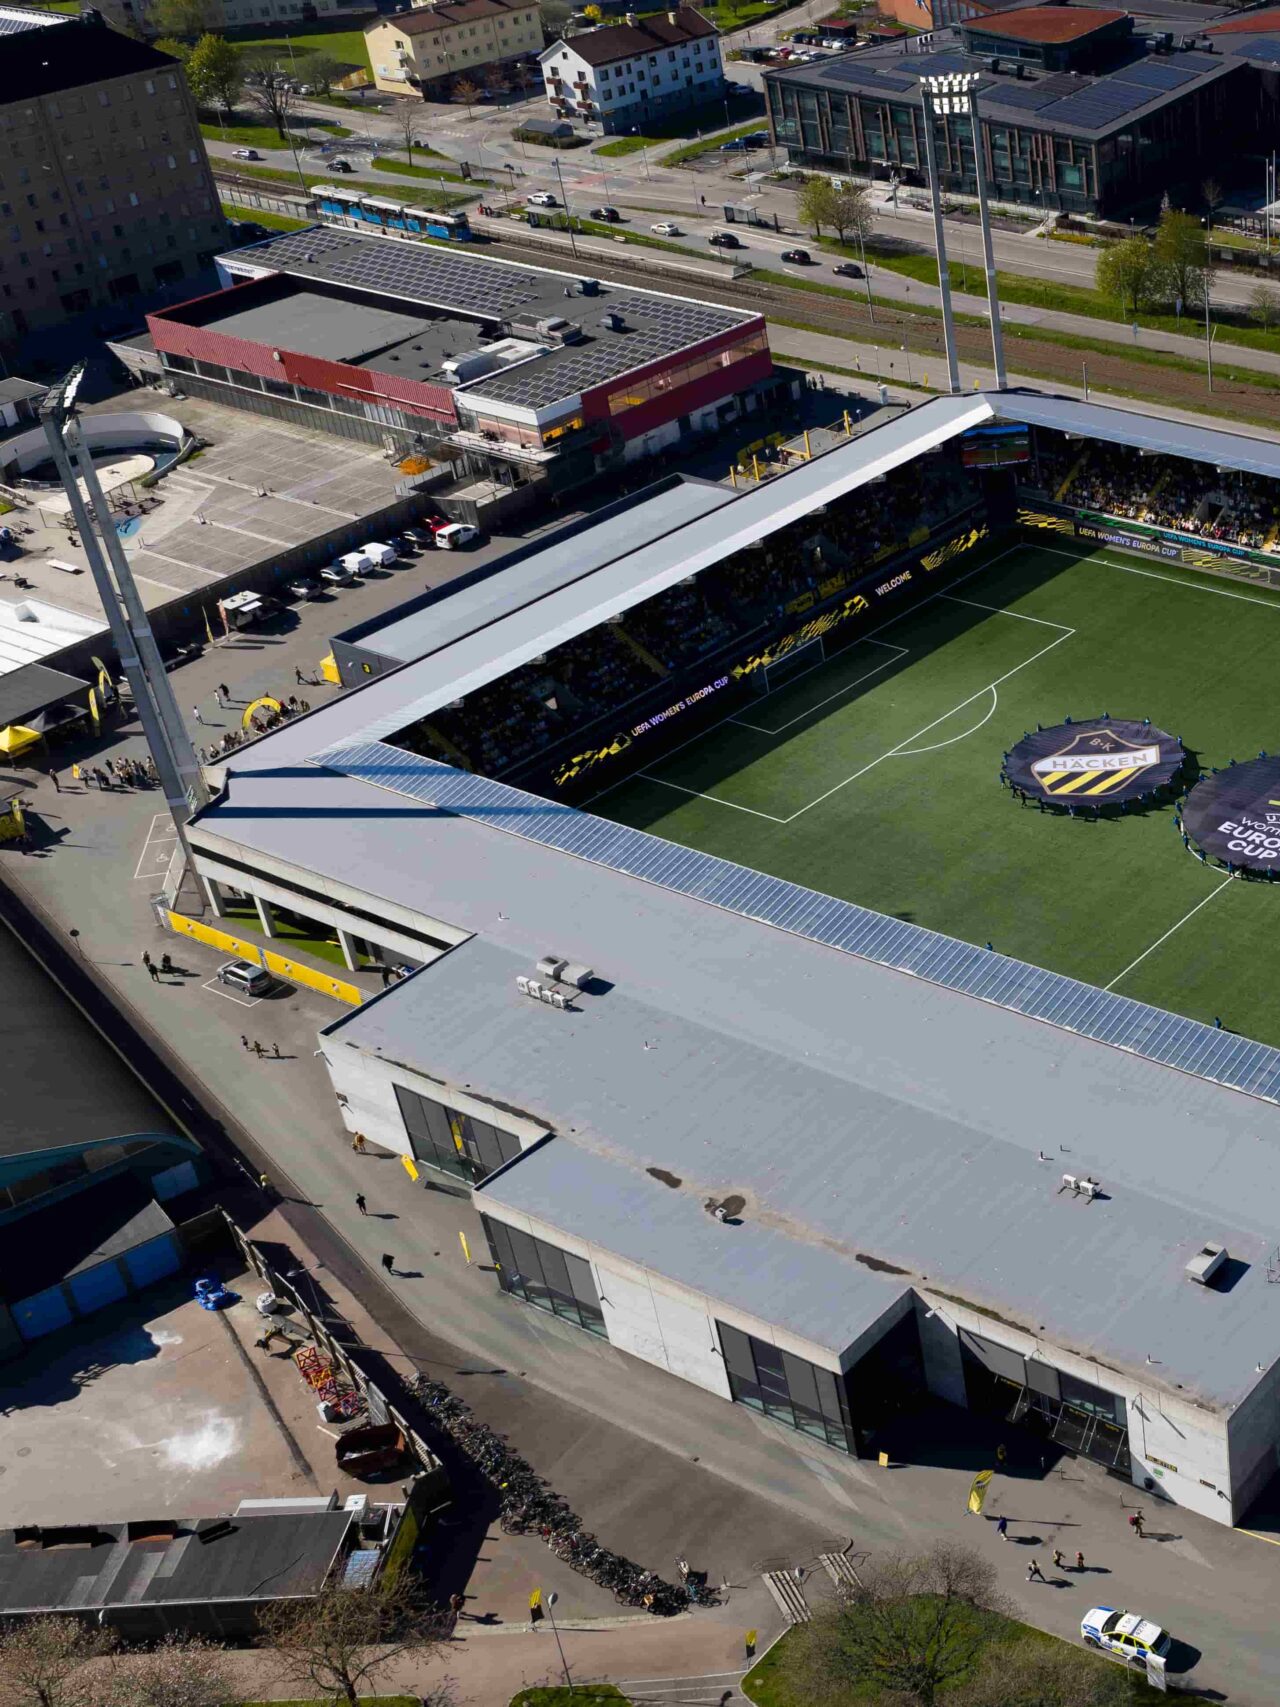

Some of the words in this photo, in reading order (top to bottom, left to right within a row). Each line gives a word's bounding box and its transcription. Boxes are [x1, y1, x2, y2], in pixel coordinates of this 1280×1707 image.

[1079, 527, 1096, 538] UEFA
[1097, 532, 1130, 546] WOMEN'S
[1132, 540, 1160, 553] EUROPA
[1161, 547, 1178, 557] CUP
[1163, 532, 1178, 541] UEFA
[1178, 535, 1206, 547] WOMEN'S
[1207, 542, 1231, 554] EUROPA
[1232, 548, 1246, 556] CUP
[875, 570, 913, 596] WELCOME
[631, 722, 651, 737] UEFA
[650, 701, 686, 726] WOMEN'S
[685, 685, 715, 706] EUROPA
[714, 675, 729, 690] CUP
[1052, 753, 1148, 770] HÄCKEN
